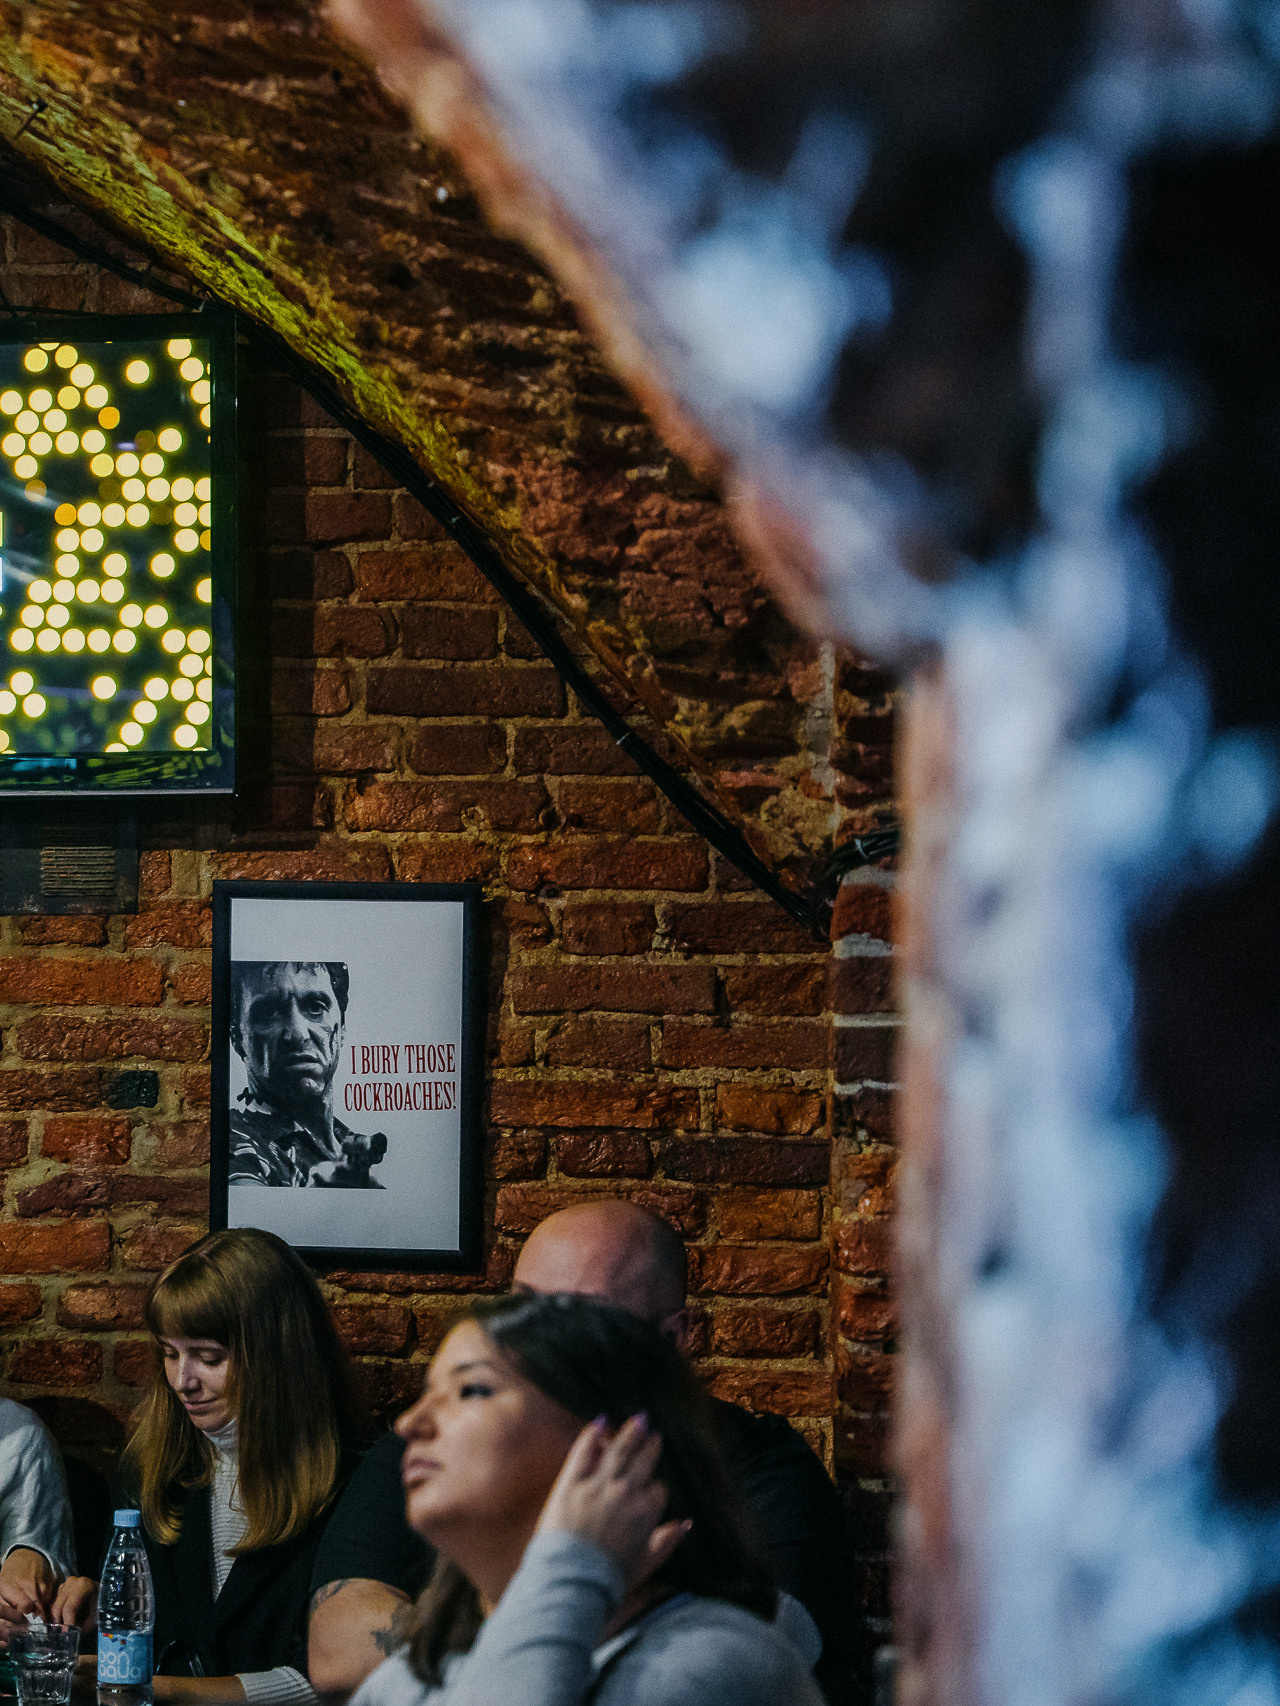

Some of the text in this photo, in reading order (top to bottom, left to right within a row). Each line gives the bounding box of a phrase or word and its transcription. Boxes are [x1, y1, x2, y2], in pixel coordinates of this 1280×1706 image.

[351, 1043, 456, 1074] I BURY THOSE
[344, 1081, 457, 1111] COCKROACHES!
